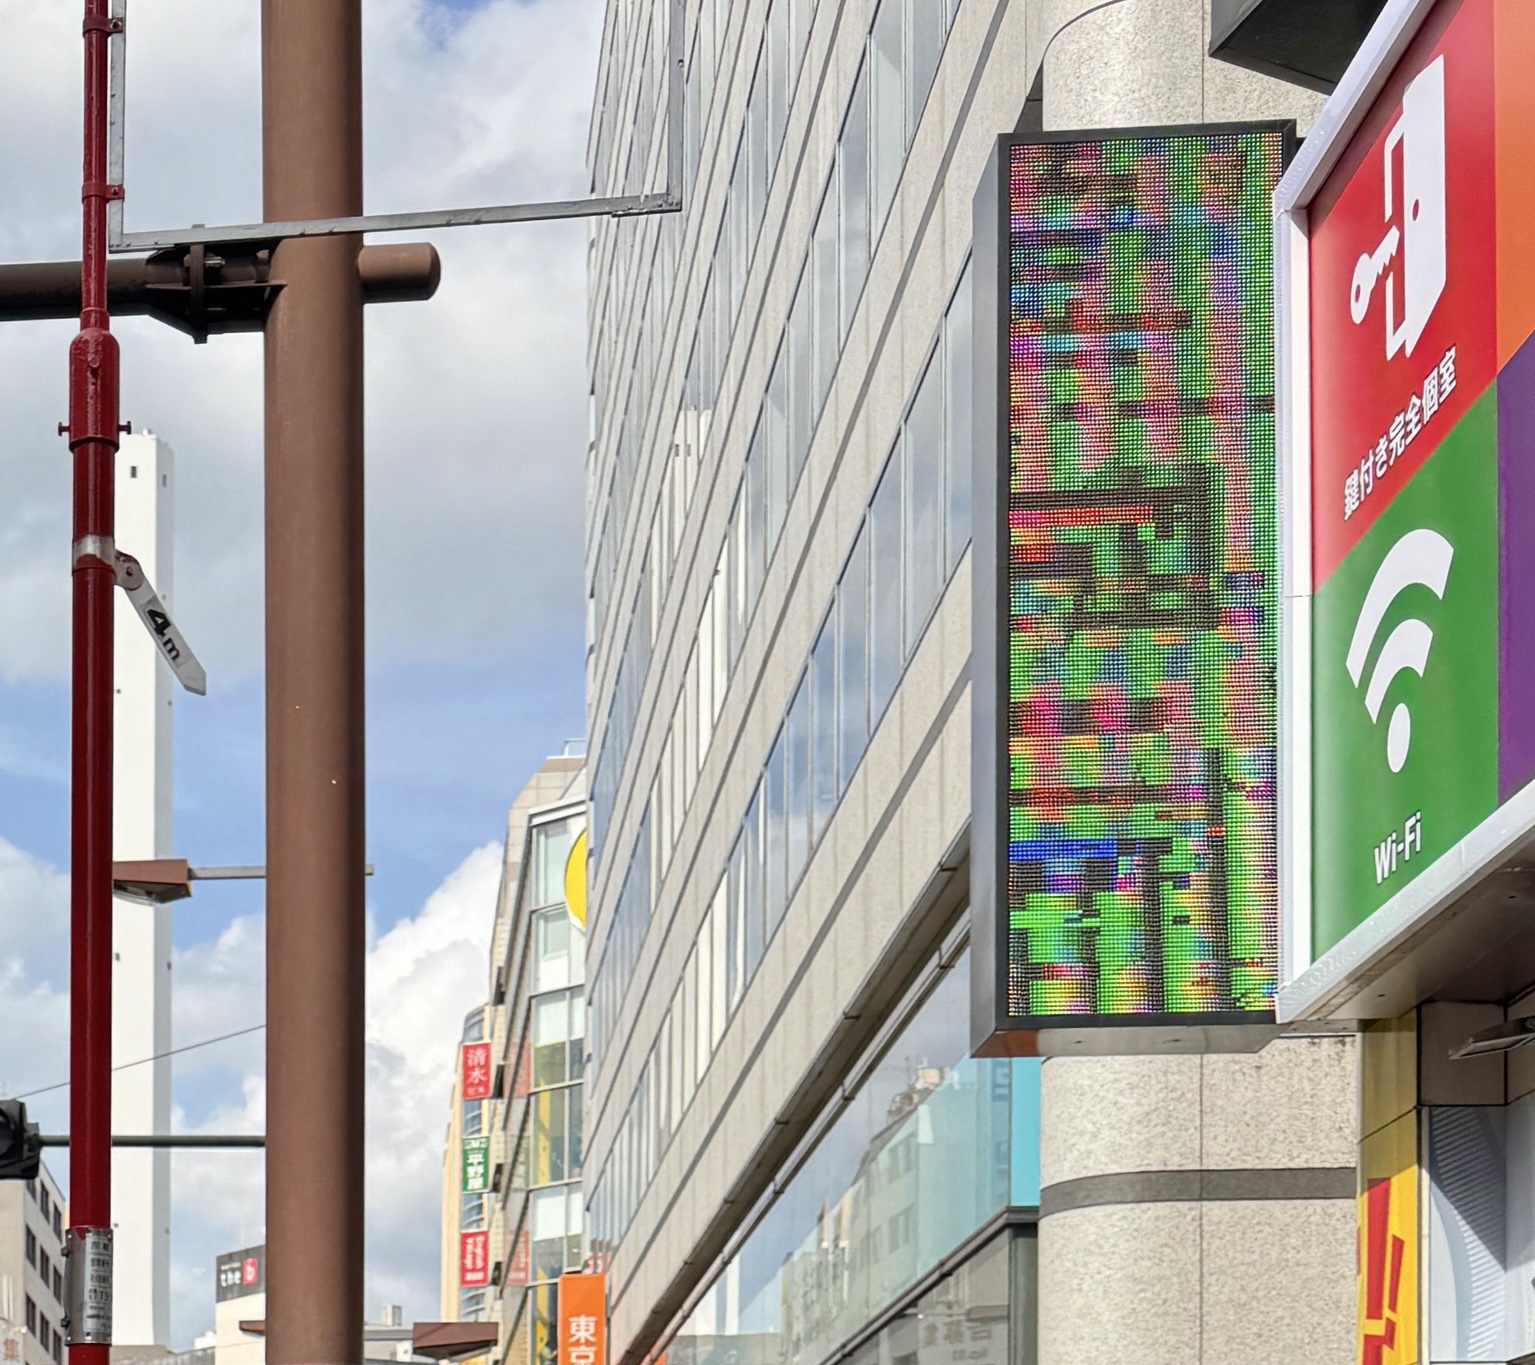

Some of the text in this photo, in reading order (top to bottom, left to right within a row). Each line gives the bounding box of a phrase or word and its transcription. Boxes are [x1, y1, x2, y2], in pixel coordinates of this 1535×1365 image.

[1344, 345, 1457, 521] 鍵付き完全個室
[147, 609, 180, 661] 4m
[1374, 811, 1421, 884] Wi-Fi
